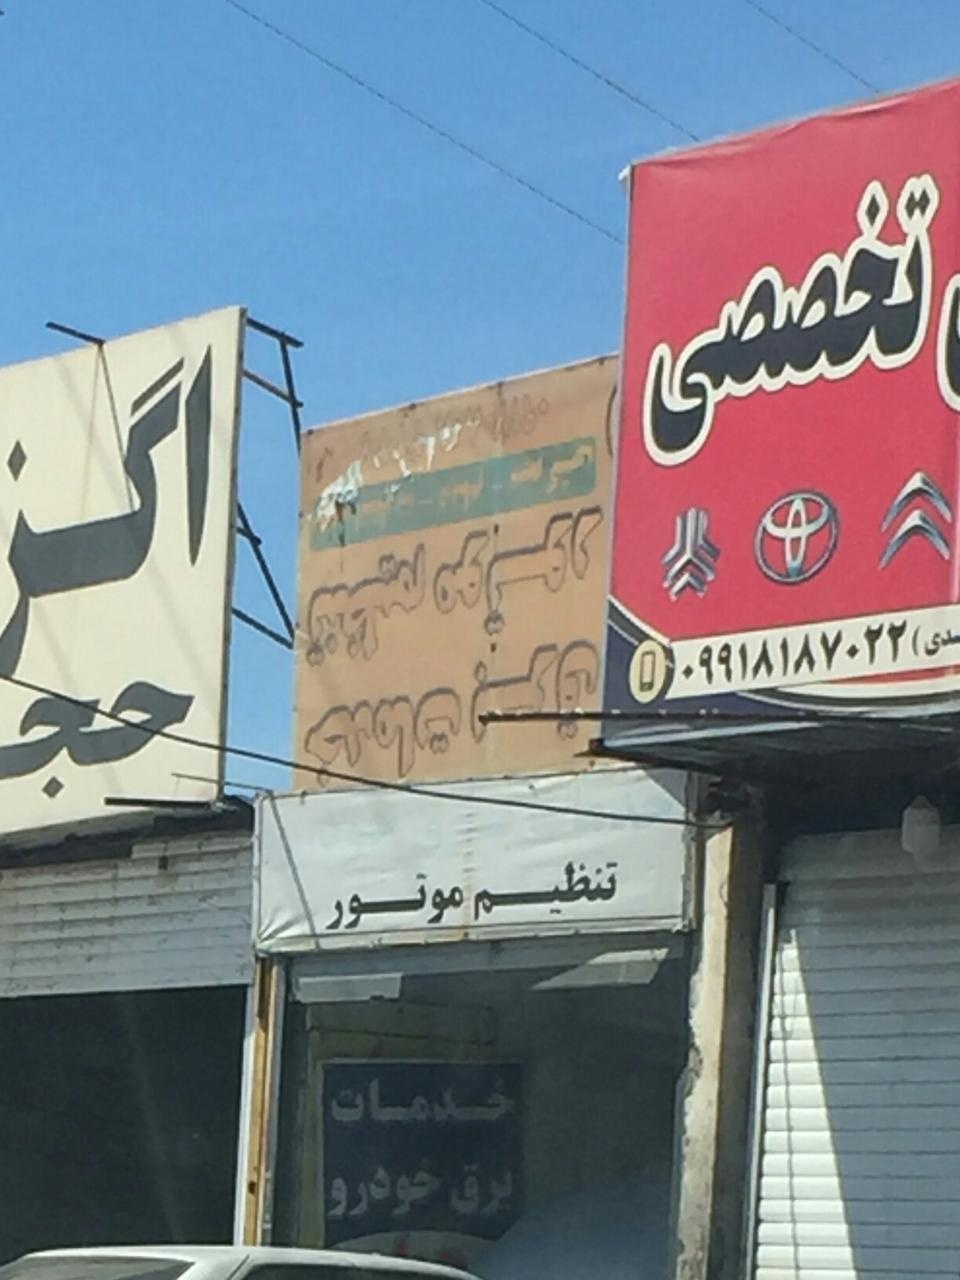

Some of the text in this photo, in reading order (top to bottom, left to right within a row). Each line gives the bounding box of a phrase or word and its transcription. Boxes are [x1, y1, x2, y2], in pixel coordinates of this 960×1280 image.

[645, 176, 937, 464] تخصصی
[682, 619, 907, 686] ۰۹۹۱۸۱۸۷۰۲۲
[325, 861, 619, 930] تنظیم موتور
[331, 1078, 514, 1123] خدمات
[327, 1157, 441, 1217] خودرو
